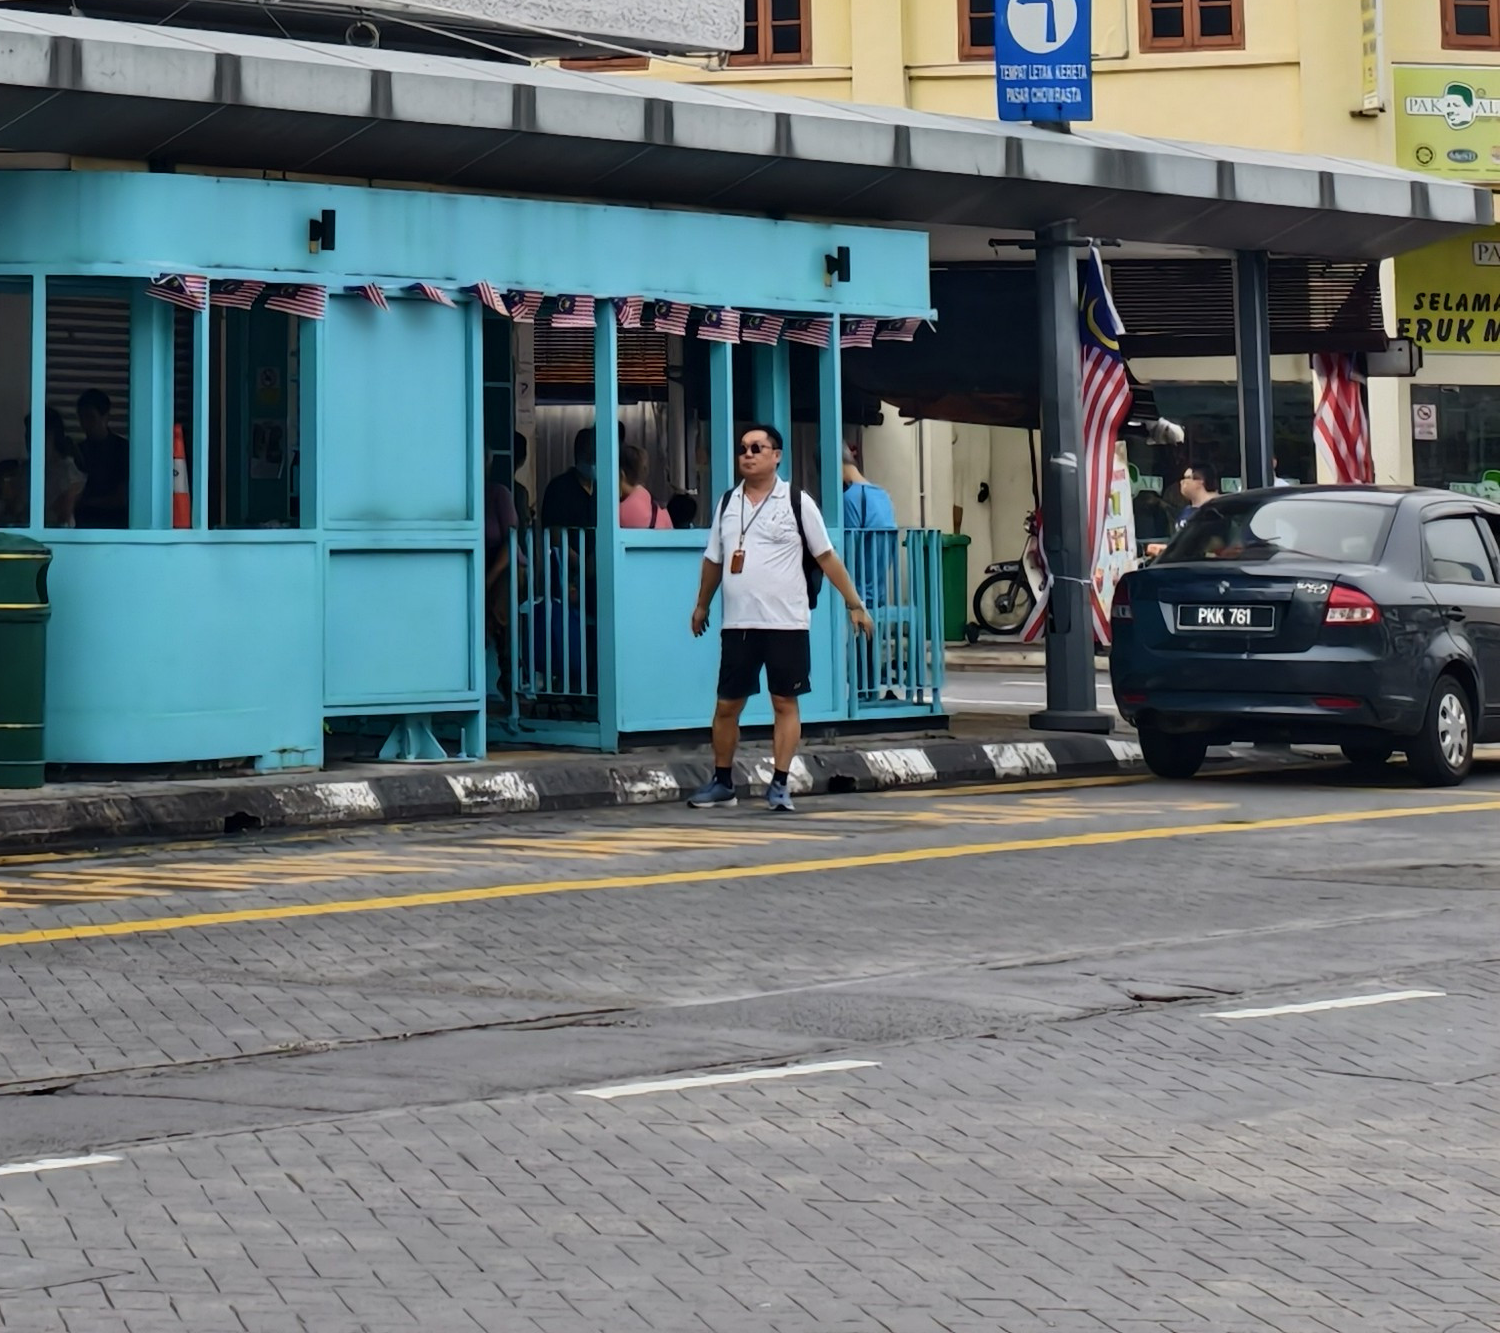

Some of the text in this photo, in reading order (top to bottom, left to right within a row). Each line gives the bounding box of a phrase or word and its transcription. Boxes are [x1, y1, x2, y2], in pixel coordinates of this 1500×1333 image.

[1000, 64, 1087, 80] TEMPAT LETAK KERETA
[1006, 87, 1082, 103] PASAR CHOWRASTA
[1409, 99, 1441, 113] PAK
[1198, 608, 1251, 624] PKK 761
